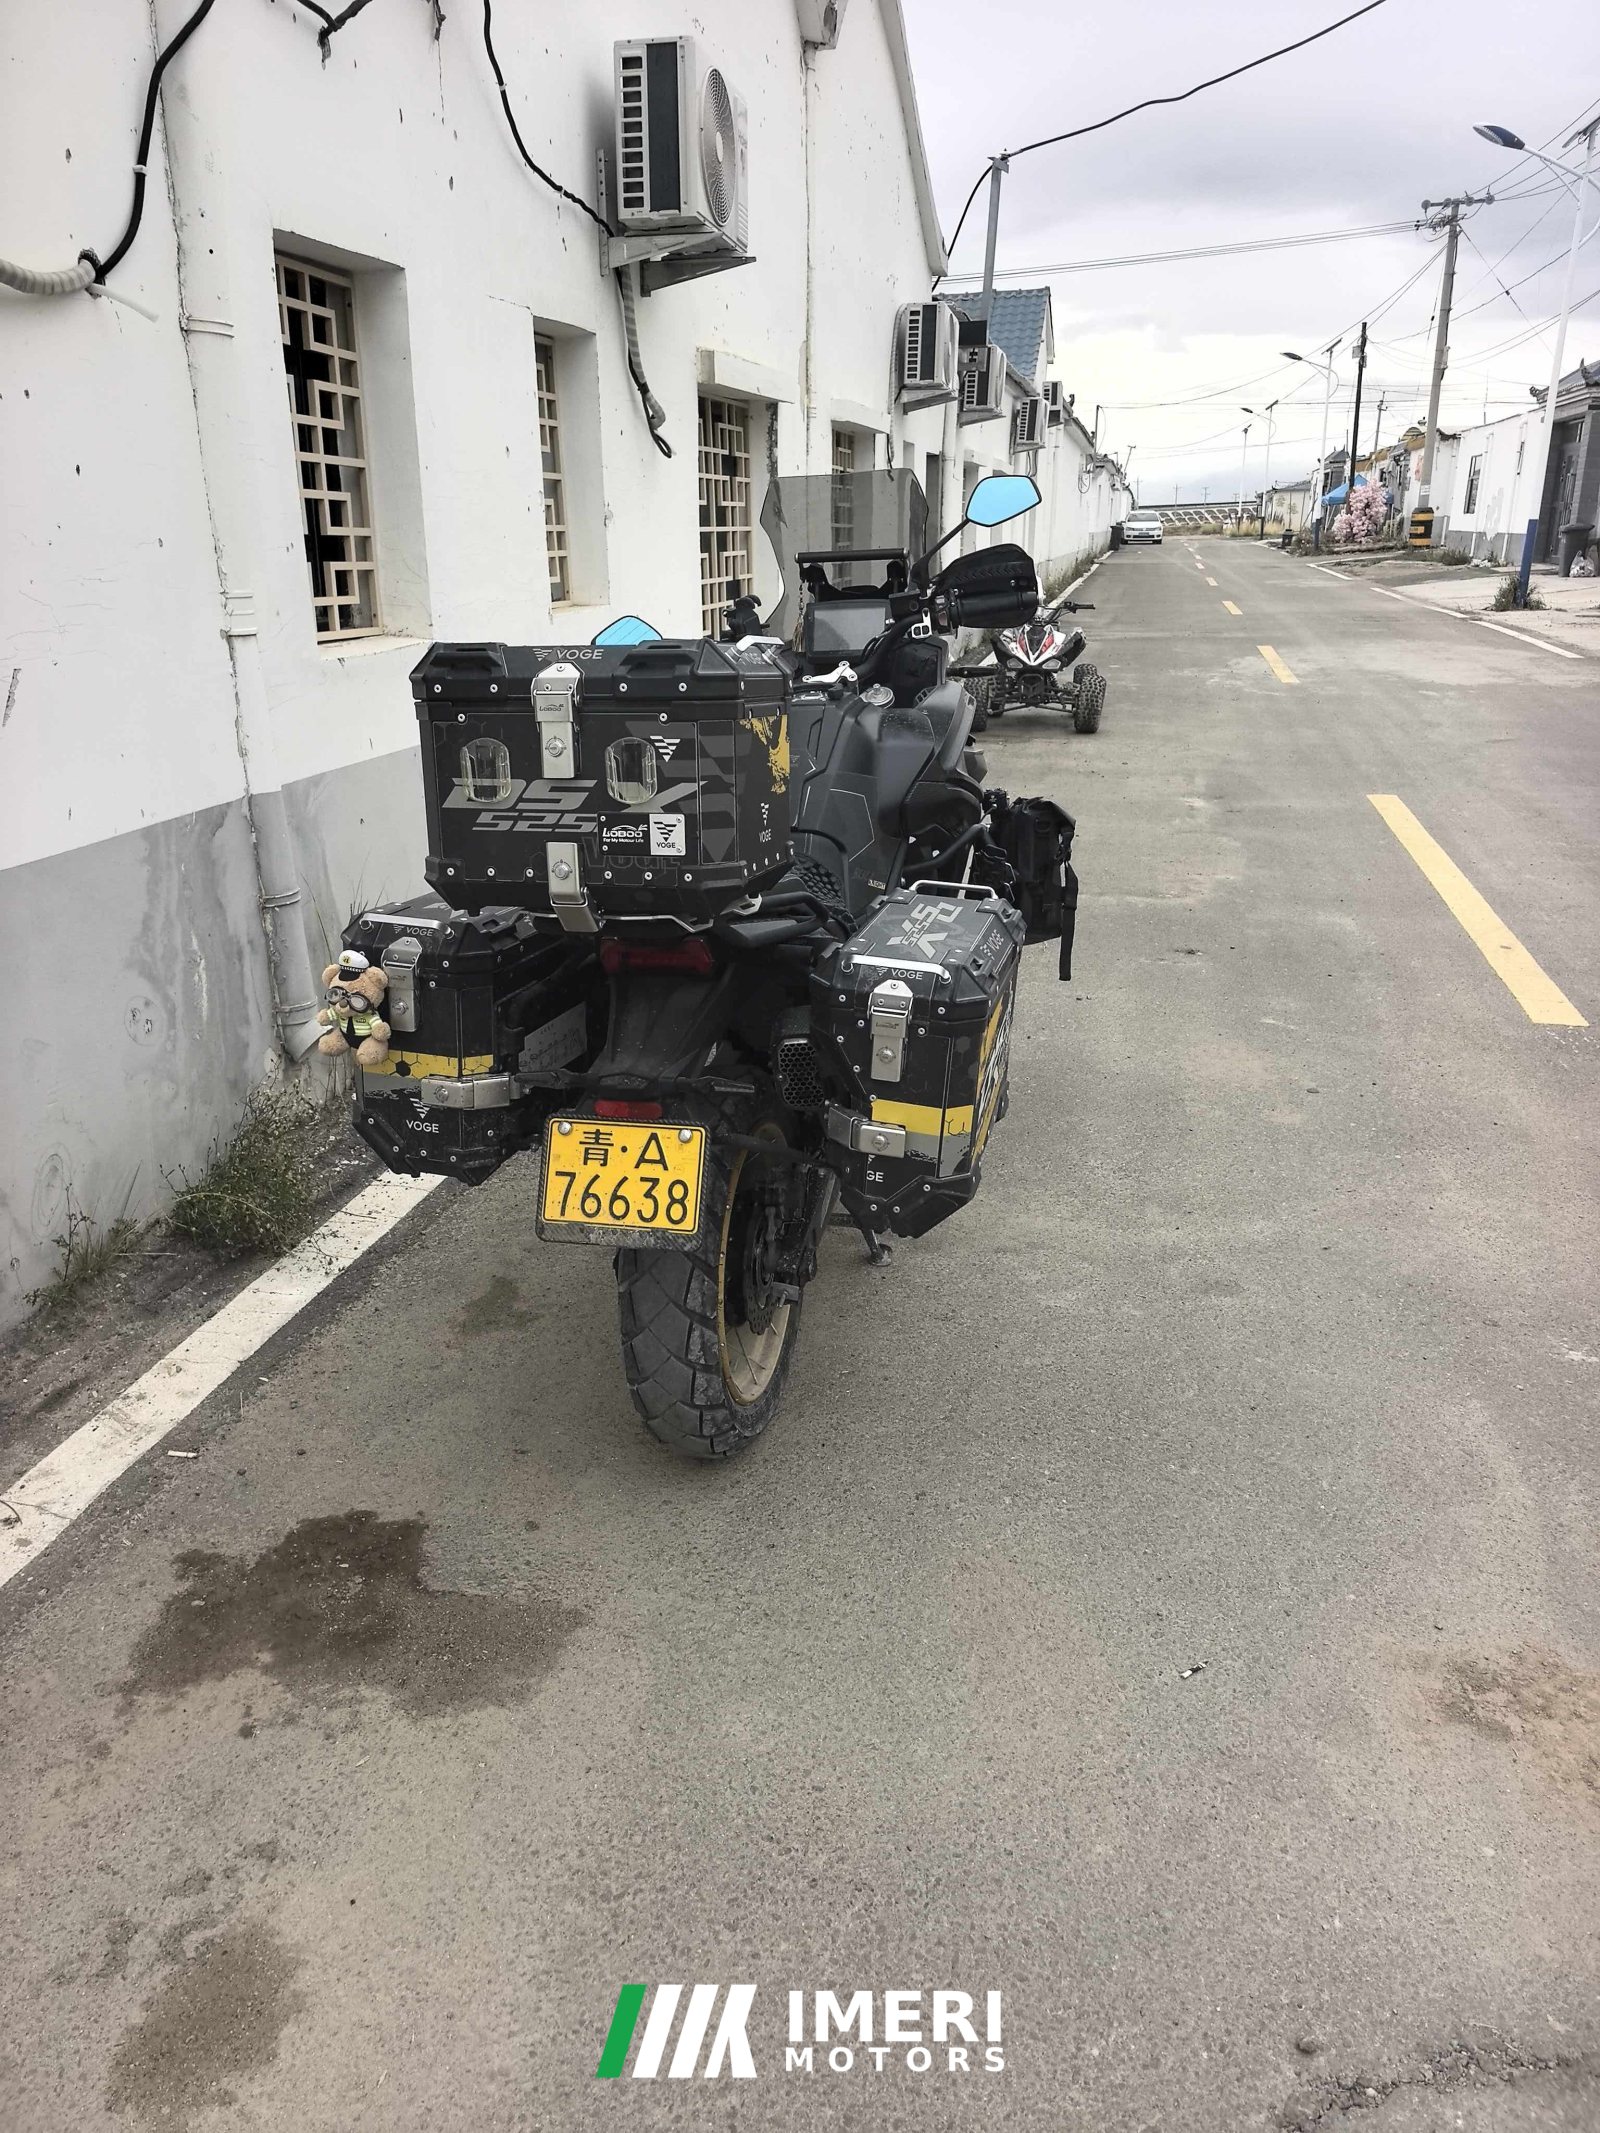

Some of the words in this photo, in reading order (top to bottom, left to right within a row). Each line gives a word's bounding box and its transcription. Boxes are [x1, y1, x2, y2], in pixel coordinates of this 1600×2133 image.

[556, 648, 604, 660] VOGE
[656, 841, 676, 849] VOGE
[406, 926, 434, 937] VOGE
[987, 929, 1005, 951] VOGE
[891, 968, 924, 981] VOGE
[406, 1119, 440, 1133] VOGE
[555, 1170, 689, 1225] 76638
